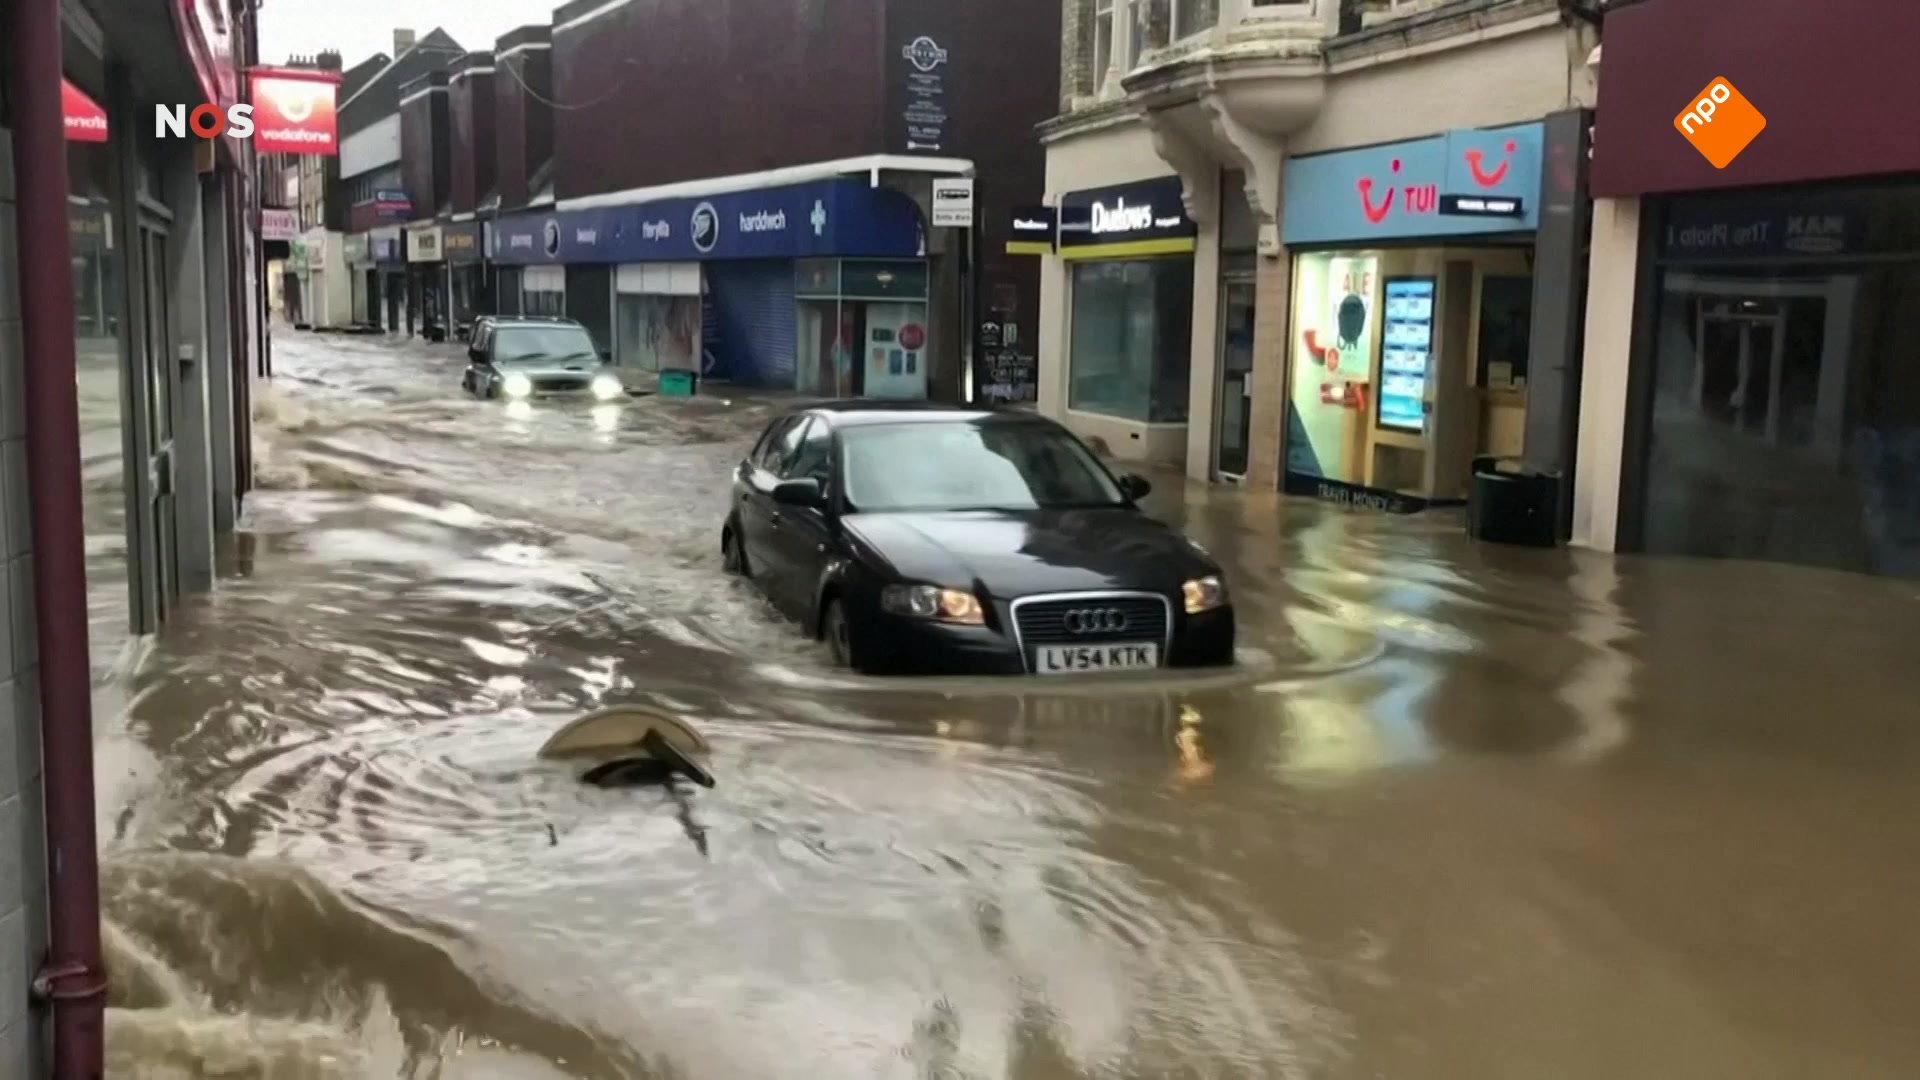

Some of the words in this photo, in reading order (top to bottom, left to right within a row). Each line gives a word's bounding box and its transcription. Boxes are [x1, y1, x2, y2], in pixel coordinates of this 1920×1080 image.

[260, 128, 332, 144] vodafone
[1404, 184, 1437, 215] TUI
[739, 208, 786, 232] harddwch
[1047, 648, 1103, 670] LV54
[1109, 646, 1148, 666] KTK
